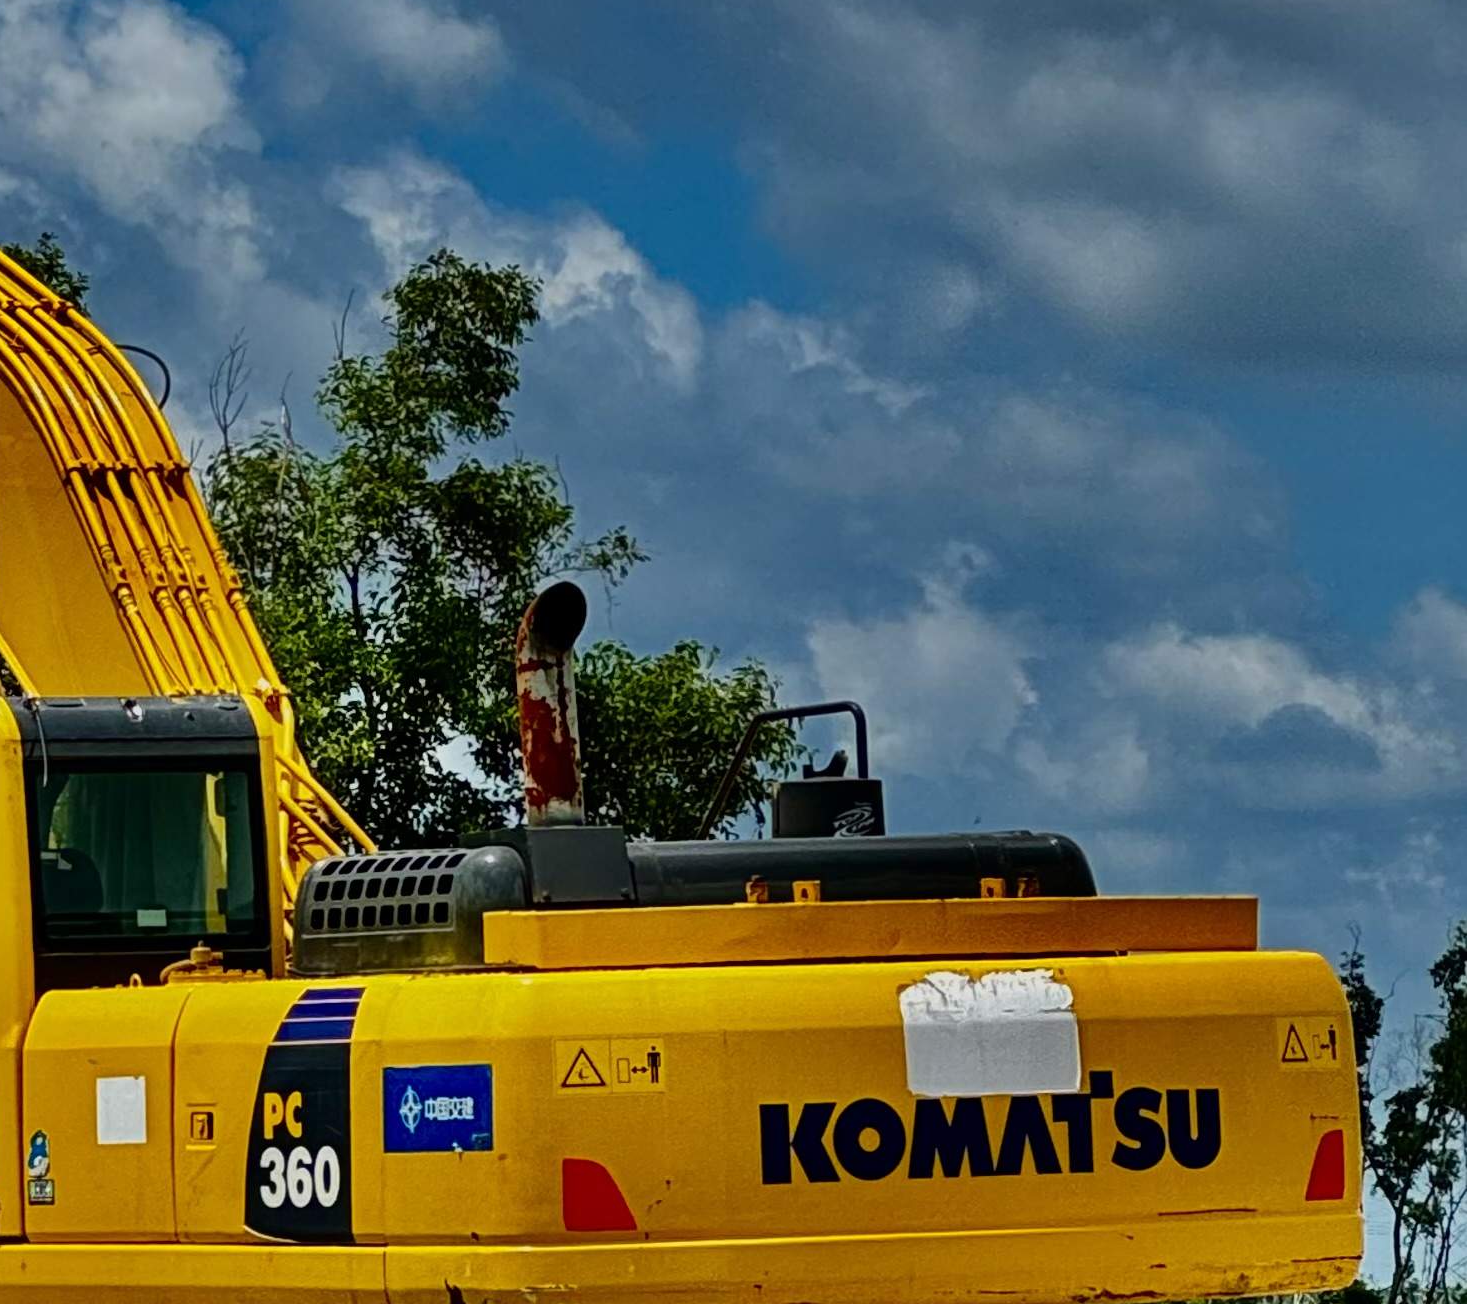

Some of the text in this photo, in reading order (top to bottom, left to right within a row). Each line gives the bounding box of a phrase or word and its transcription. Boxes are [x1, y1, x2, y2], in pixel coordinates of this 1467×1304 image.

[264, 1091, 302, 1140] PC
[759, 1070, 1221, 1184] KOMATSU
[260, 1145, 340, 1208] 360
